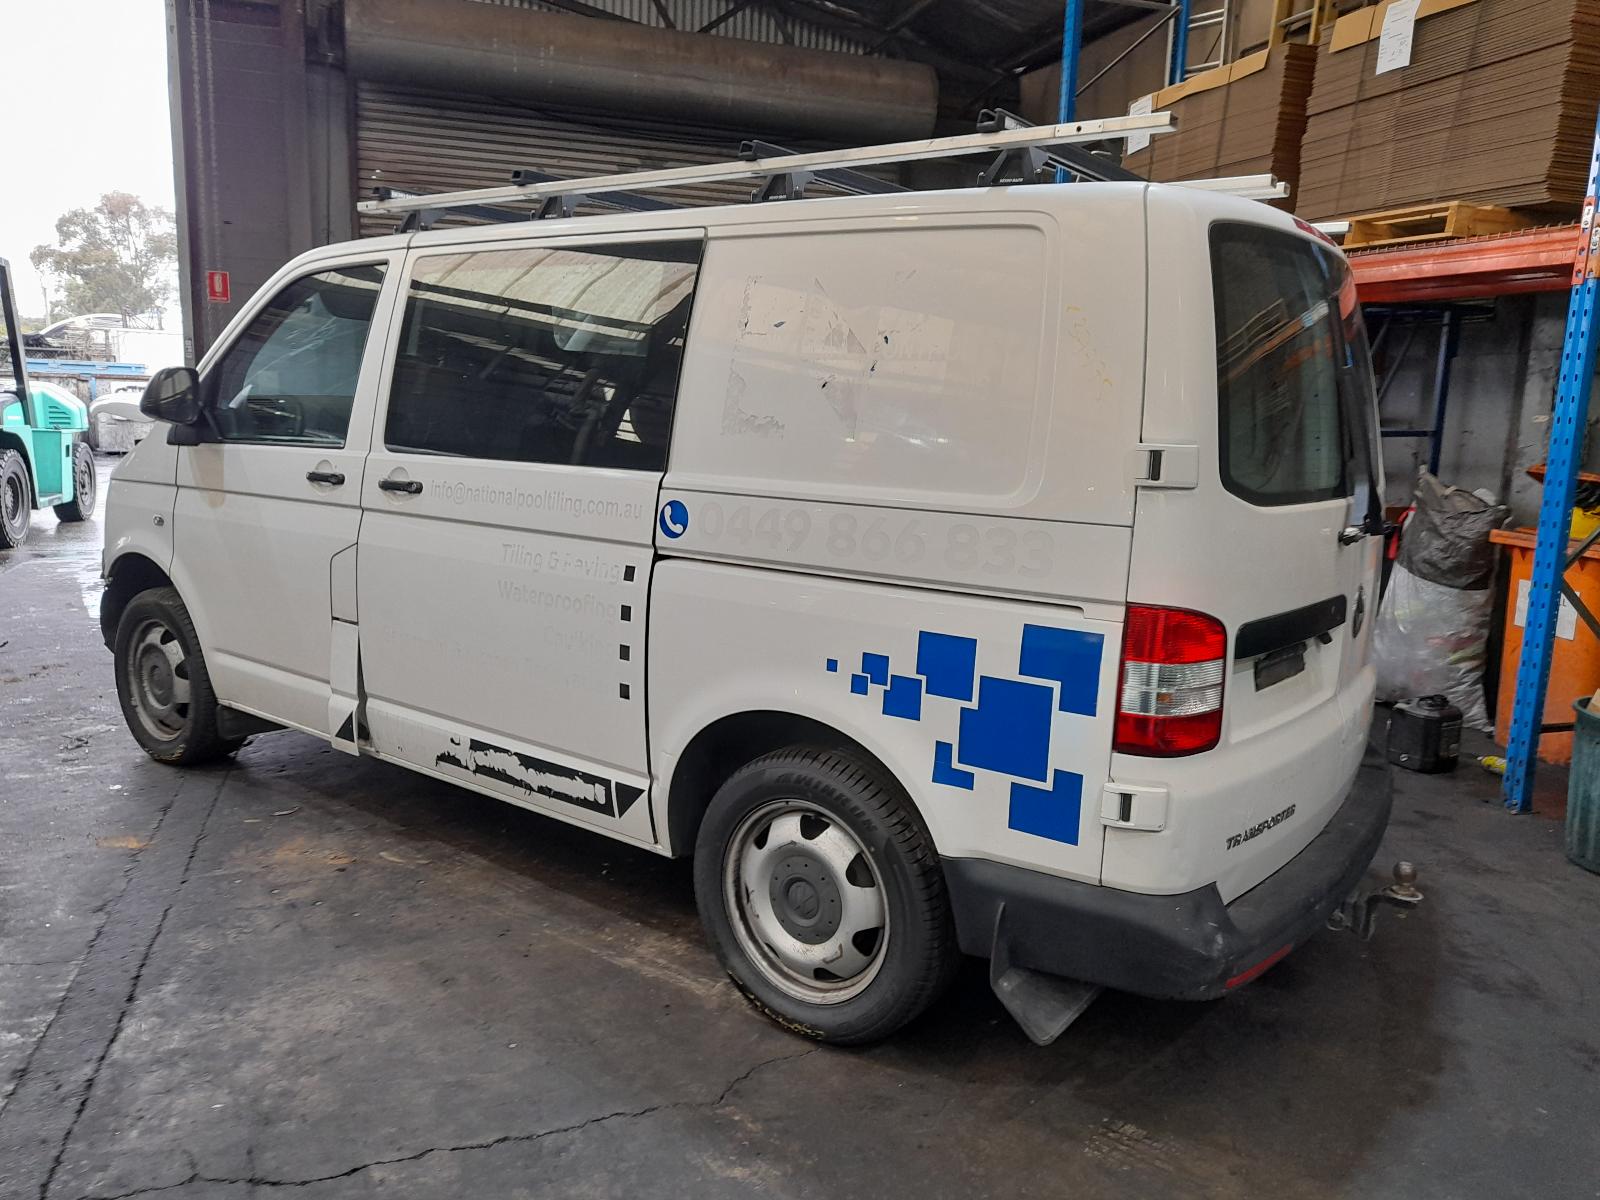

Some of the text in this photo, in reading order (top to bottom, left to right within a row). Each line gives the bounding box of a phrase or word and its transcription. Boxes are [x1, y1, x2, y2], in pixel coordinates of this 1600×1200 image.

[430, 480, 643, 519] info@nationalpooltiling.com.au
[502, 543, 543, 573] Tiling
[697, 501, 1055, 578] 0449 866 833
[497, 579, 616, 624] Waterproofing
